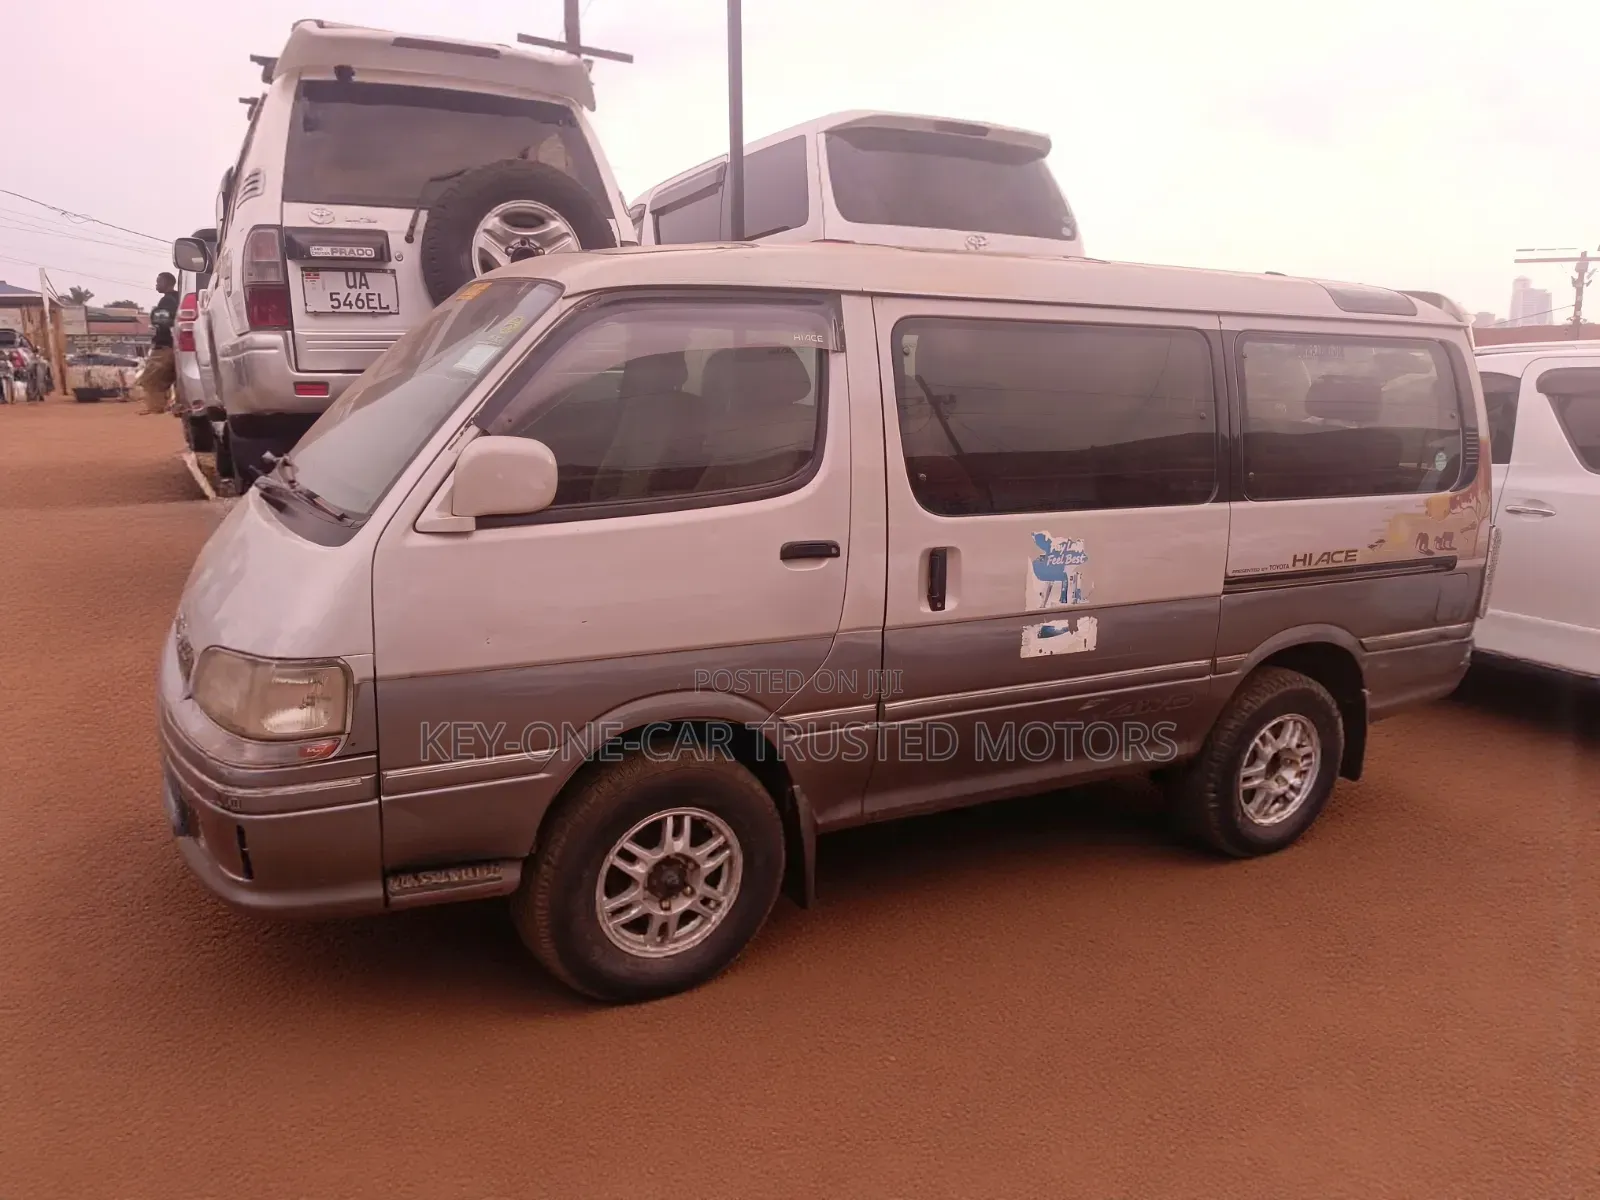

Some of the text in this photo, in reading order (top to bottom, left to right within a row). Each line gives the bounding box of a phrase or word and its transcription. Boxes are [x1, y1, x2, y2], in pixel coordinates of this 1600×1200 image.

[330, 247, 374, 257] PRADO
[344, 271, 370, 290] UA
[329, 292, 390, 310] 546EL
[793, 334, 824, 343] HIACE
[1046, 553, 1086, 567] Feel Best
[1269, 563, 1289, 571] TOYOTA
[1292, 549, 1358, 567] HIACE
